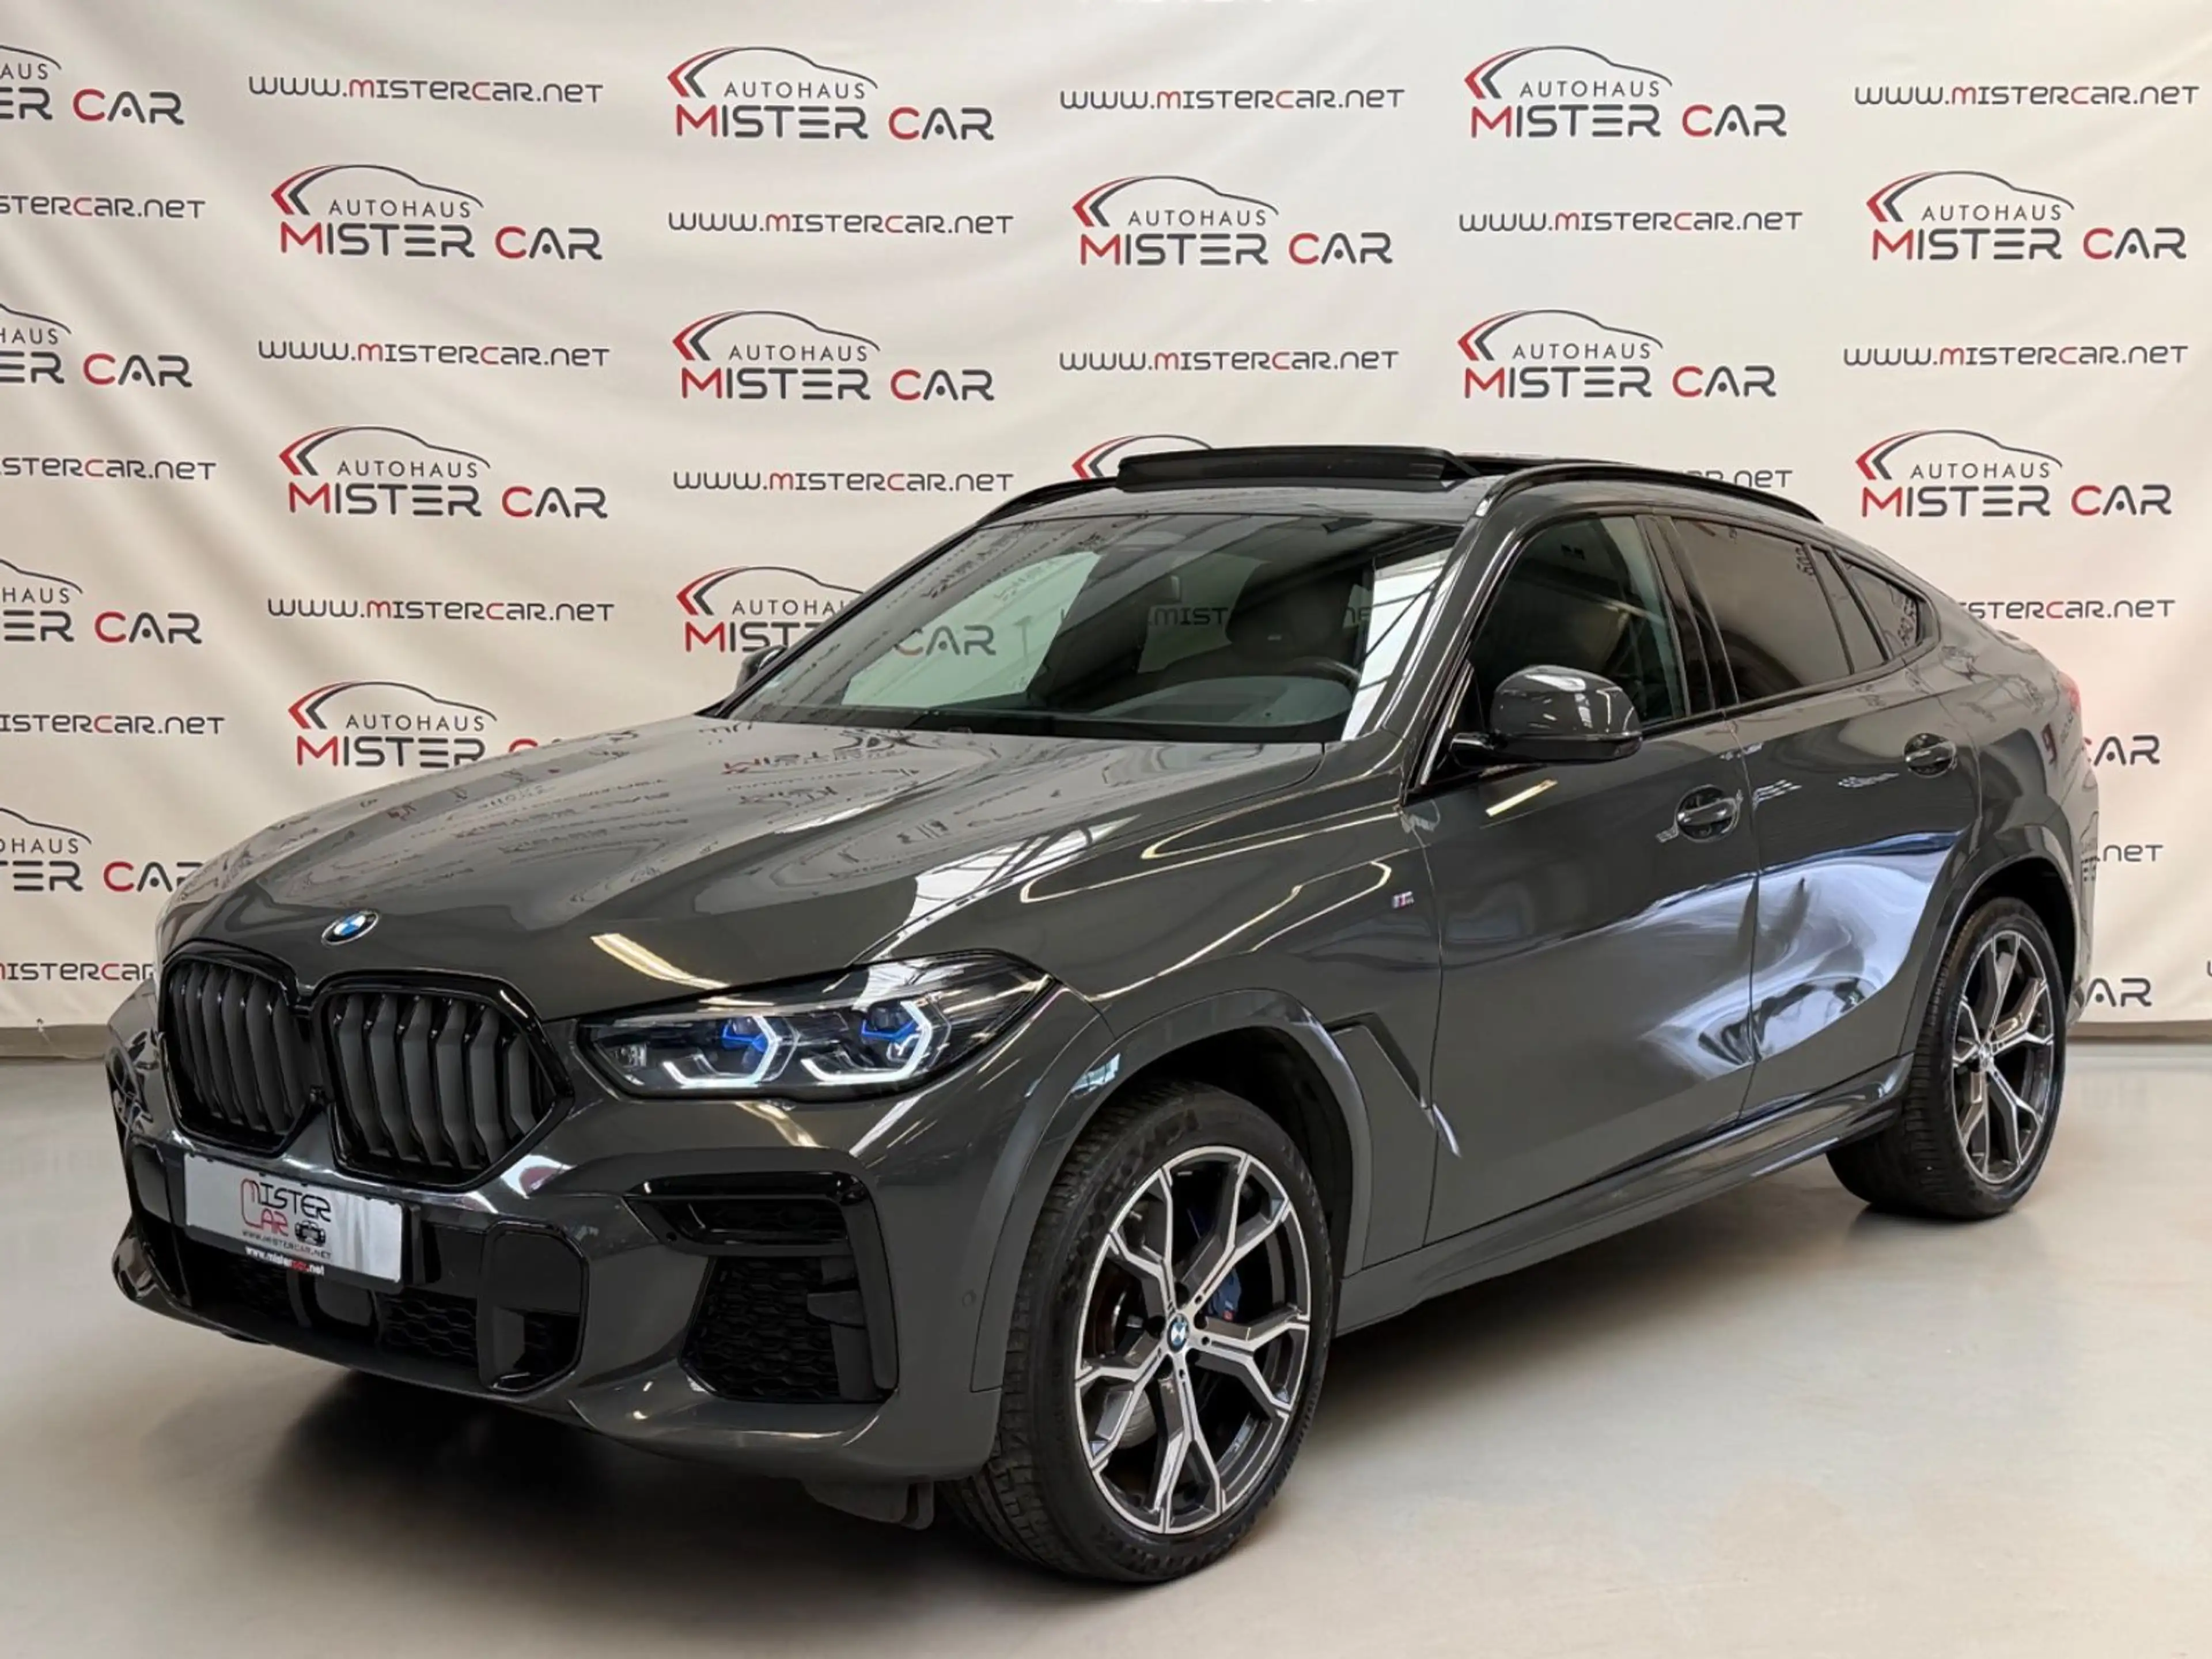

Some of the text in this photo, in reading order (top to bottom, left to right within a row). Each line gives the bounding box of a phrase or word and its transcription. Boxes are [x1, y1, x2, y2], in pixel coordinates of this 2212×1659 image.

[724, 82, 865, 99] AUTOHAUS
[1520, 81, 1659, 97] AUTOHAUS
[73, 89, 184, 125] CAR
[676, 104, 994, 141] MISTER CAR
[1471, 104, 1787, 138] MISTER CAR
[329, 199, 470, 218] AUTOHAUS
[1128, 210, 1266, 226] AUTOHAUS
[1922, 204, 2061, 221] AUTOHAUS
[281, 221, 603, 260] MISTER CAR
[1081, 232, 1393, 266] MISTER CAR
[1873, 228, 2187, 260] MISTER CAR
[729, 344, 867, 362] AUTOHAUS
[1512, 343, 1650, 359] AUTOHAUS
[84, 354, 192, 388] CAR
[681, 367, 994, 401] MISTER CAR
[1465, 366, 1777, 399] MISTER CAR
[338, 460, 477, 478] AUTOHAUS
[1910, 462, 2049, 479] AUTOHAUS
[289, 482, 608, 518] MISTER CAR
[1862, 484, 2172, 517] MISTER CAR
[2, 587, 70, 604] HAUS
[3, 609, 202, 644] ER CAR
[346, 714, 483, 731] AUTOHAUS
[297, 736, 484, 768] MISTER
[2084, 734, 2161, 767] AR
[2086, 978, 2152, 1007] AR
